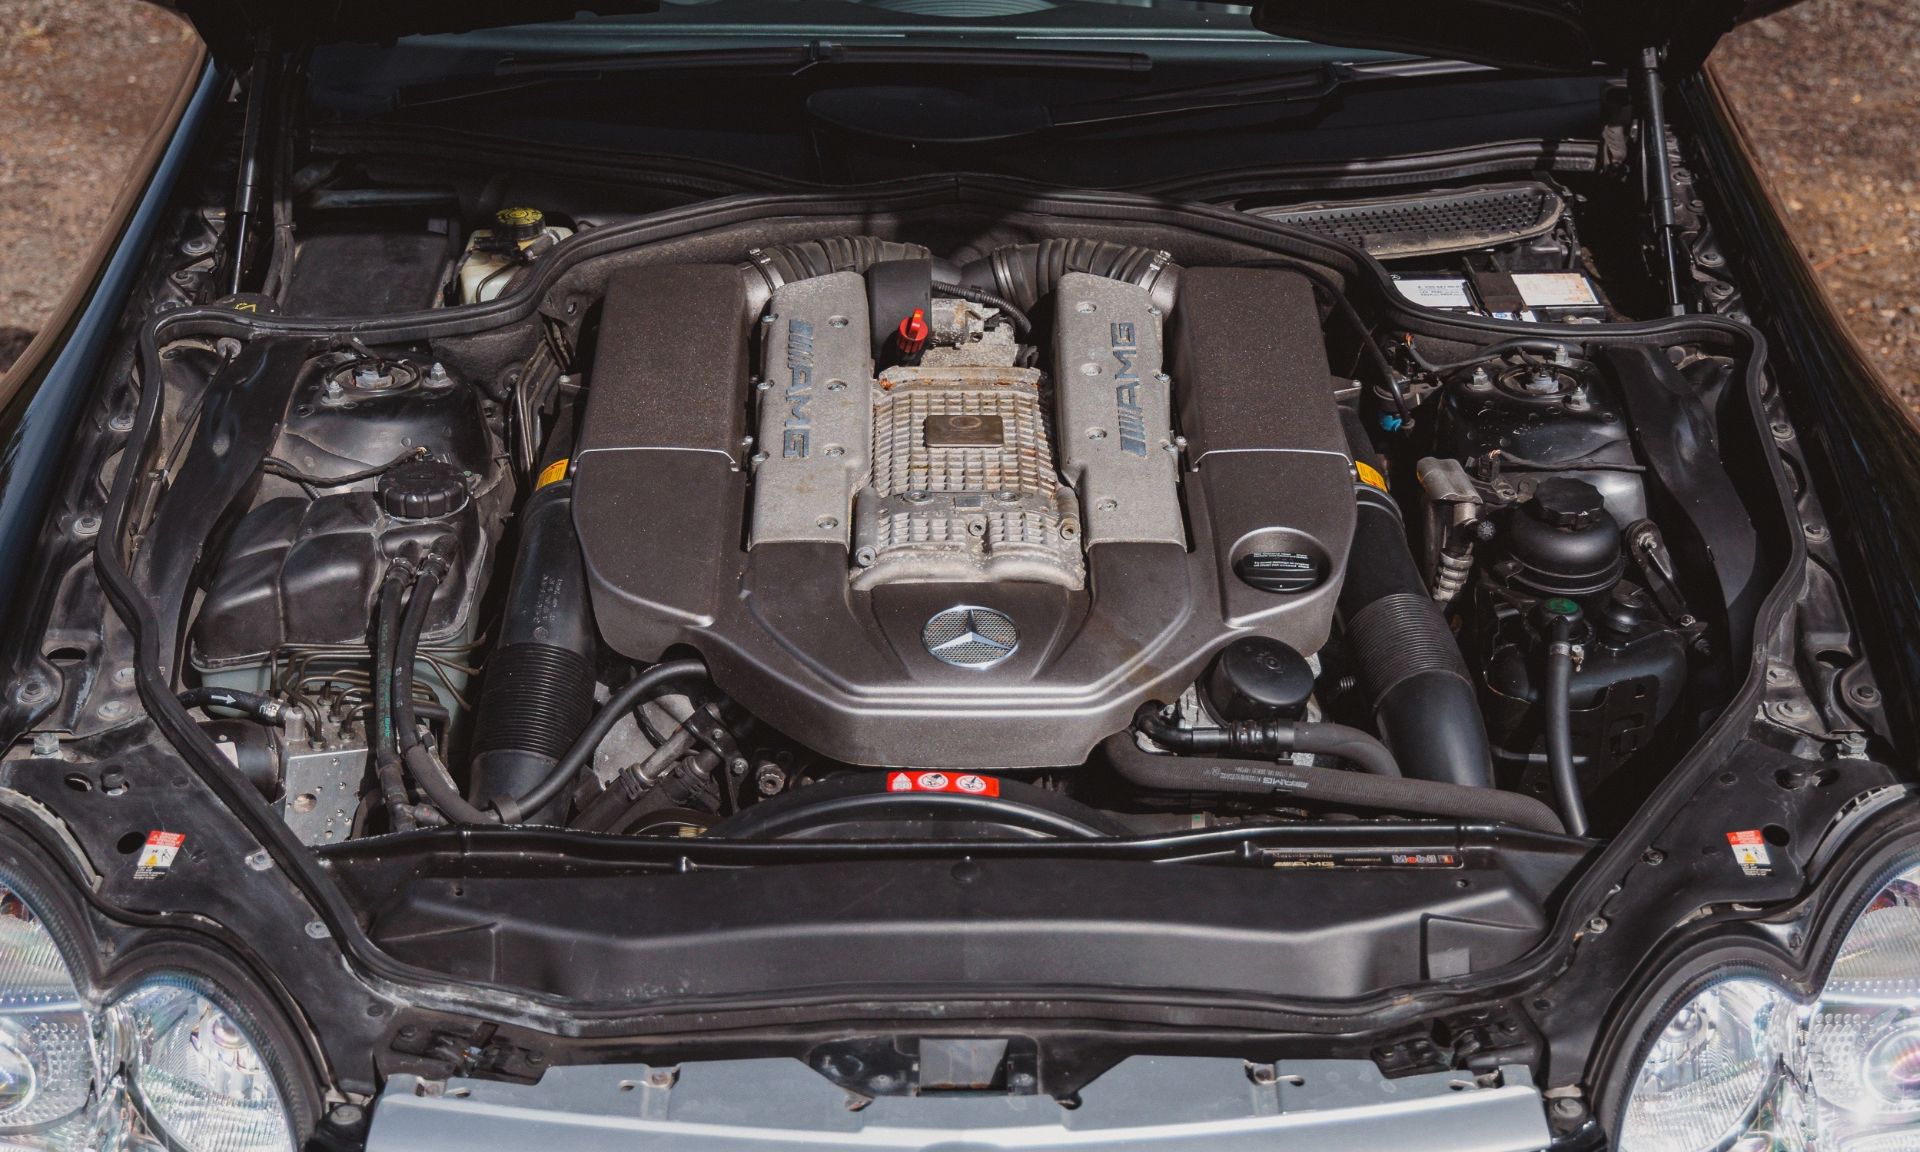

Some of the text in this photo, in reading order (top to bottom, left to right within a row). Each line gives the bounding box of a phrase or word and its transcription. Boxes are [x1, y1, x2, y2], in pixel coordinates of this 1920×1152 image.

[1110, 321, 1143, 415] AMG
[783, 361, 812, 458] AMG
[1262, 775, 1297, 787] AMG
[1289, 861, 1335, 869] AMG
[1391, 854, 1438, 864] Mobil
